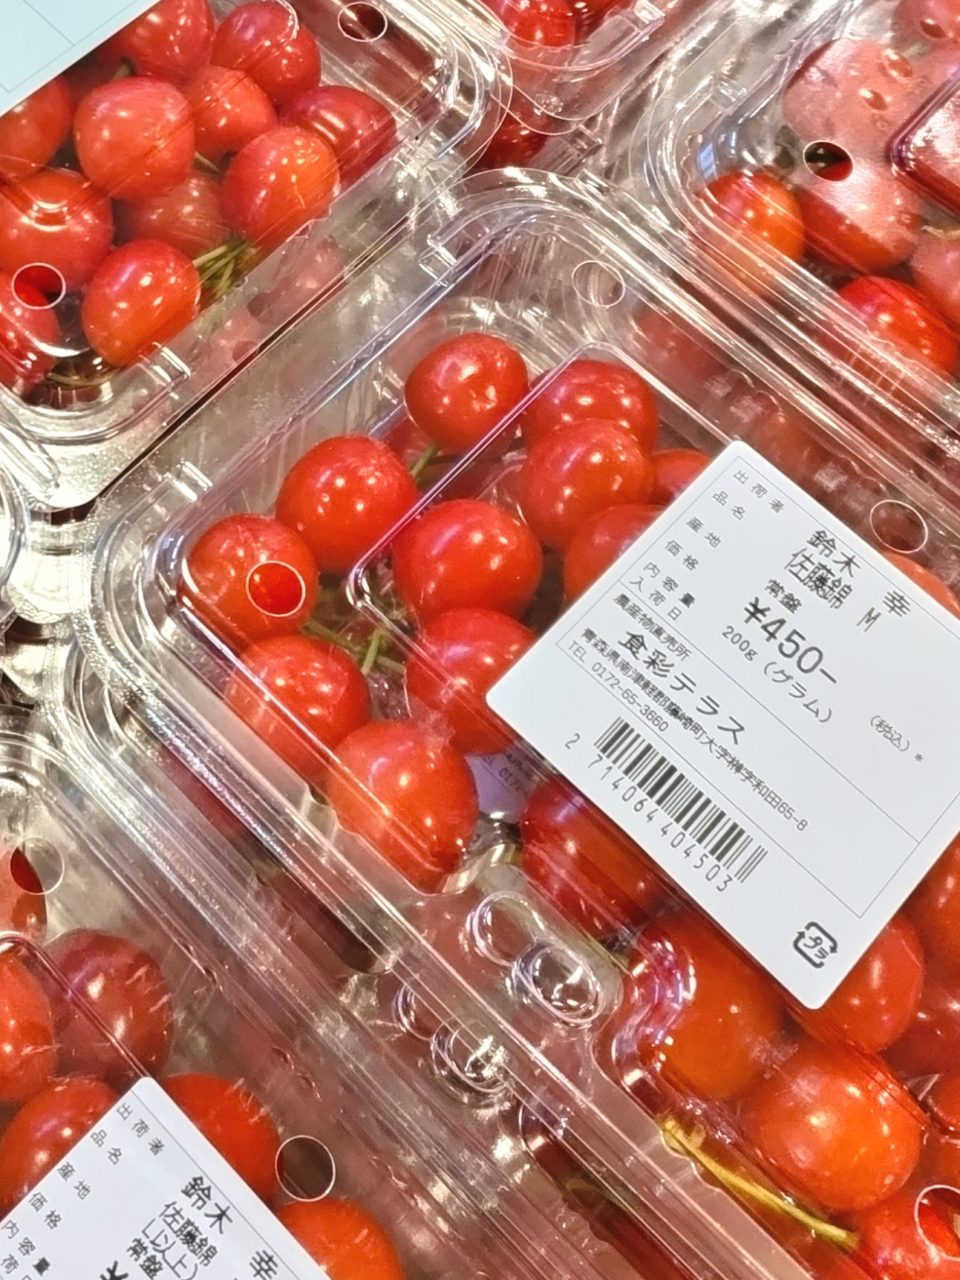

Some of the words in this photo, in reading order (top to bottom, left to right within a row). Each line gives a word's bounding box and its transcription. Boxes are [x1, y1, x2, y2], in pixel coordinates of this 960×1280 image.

[643, 562, 695, 609] 内容量
[686, 516, 721, 548] 産地
[764, 579, 802, 614] 常盤
[711, 490, 746, 521] 品名
[784, 547, 853, 609] 佐藤錦
[856, 606, 882, 632] M
[732, 469, 785, 514] 出荷者
[806, 529, 861, 578] 鈴木
[882, 590, 911, 617] 幸
[613, 592, 692, 661] 農産物直売所
[629, 575, 682, 622] 入荷日
[664, 539, 699, 571] 価格
[743, 596, 837, 684] ¥450-
[568, 639, 588, 664] TEL
[591, 661, 669, 732] 0172-65-3660
[617, 631, 745, 745] 食彩テラス
[564, 732, 581, 750] 2
[28, 1192, 63, 1230] 価格
[57, 1162, 91, 1200] 産地
[126, 1237, 164, 1280] 常盤
[90, 1129, 124, 1165] 品名
[159, 1201, 218, 1267] 佐藤錦
[116, 1102, 165, 1156] 出荷者
[181, 1176, 233, 1234] 鈴木
[249, 1250, 279, 1280] 幸
[1, 1220, 52, 1276] 内容量
